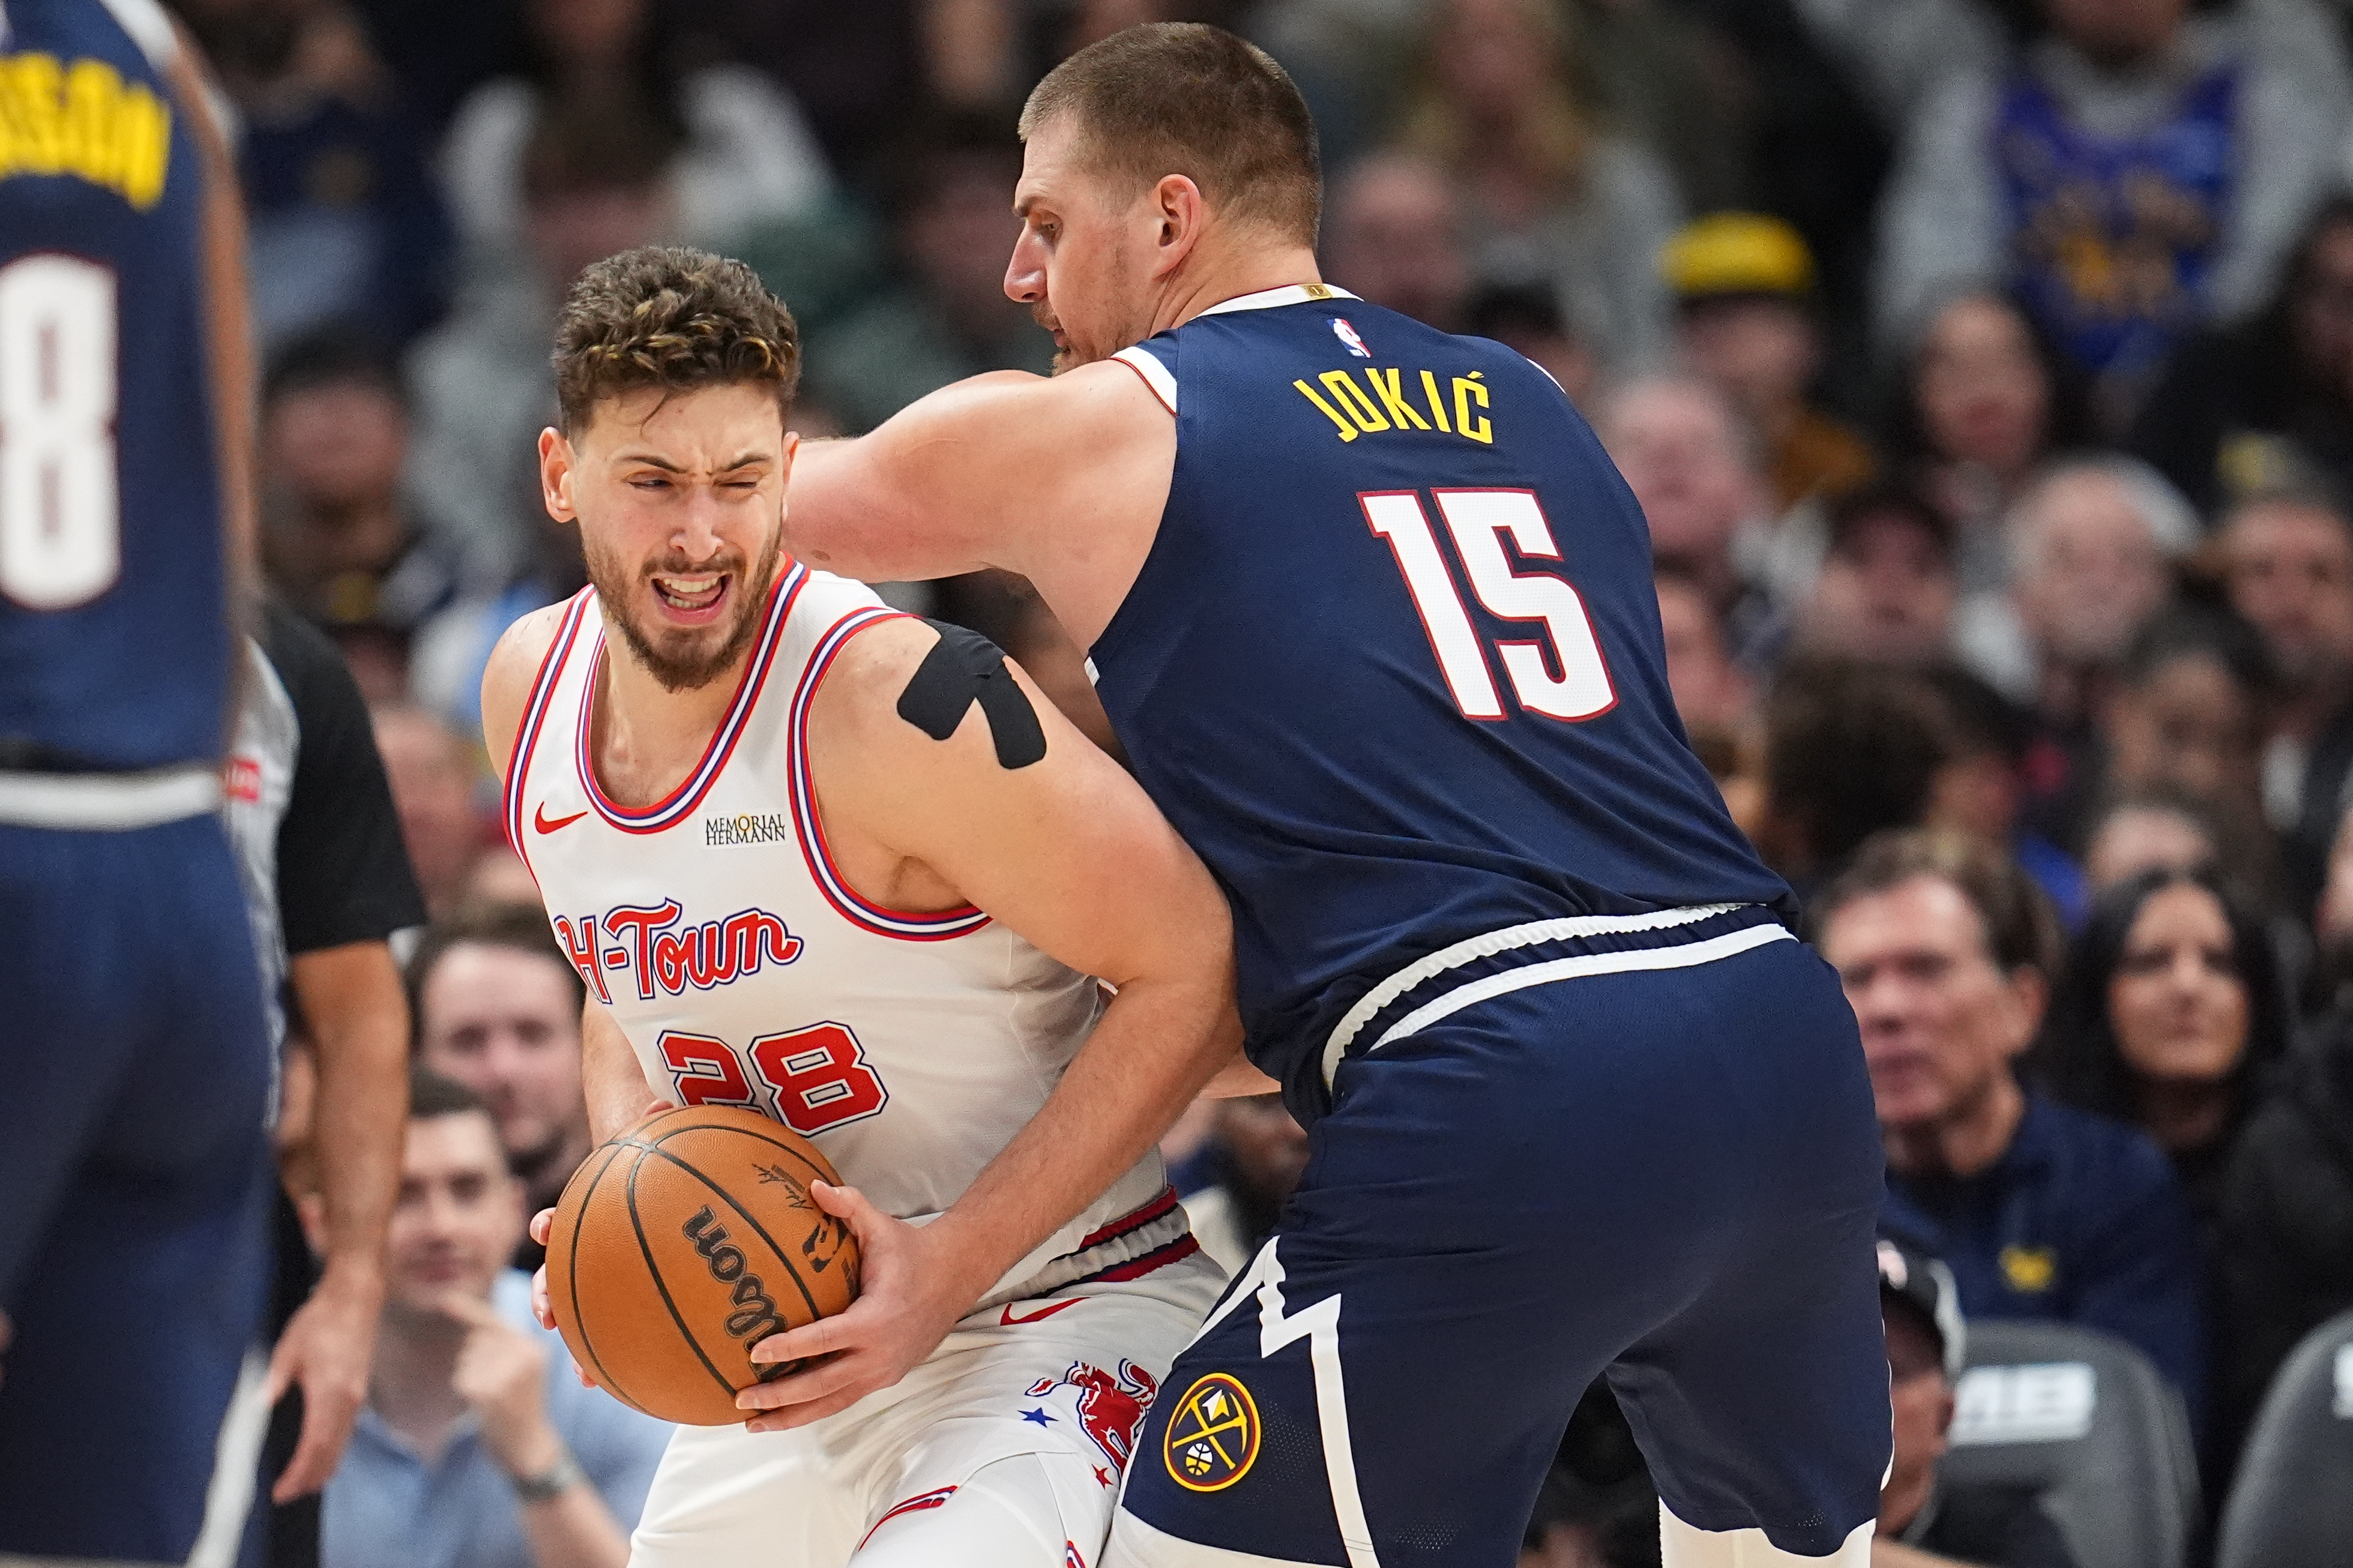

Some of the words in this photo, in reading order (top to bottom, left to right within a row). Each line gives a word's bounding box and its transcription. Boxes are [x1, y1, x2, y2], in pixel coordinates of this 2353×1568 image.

[0, 250, 121, 612] 8
[1292, 368, 1494, 444] JOKIĆ
[1355, 487, 1620, 723] 15
[706, 813, 785, 833] MEMORIAL
[706, 826, 786, 846] HERMANN
[553, 897, 804, 1005] H-Town
[656, 1020, 890, 1138] 28
